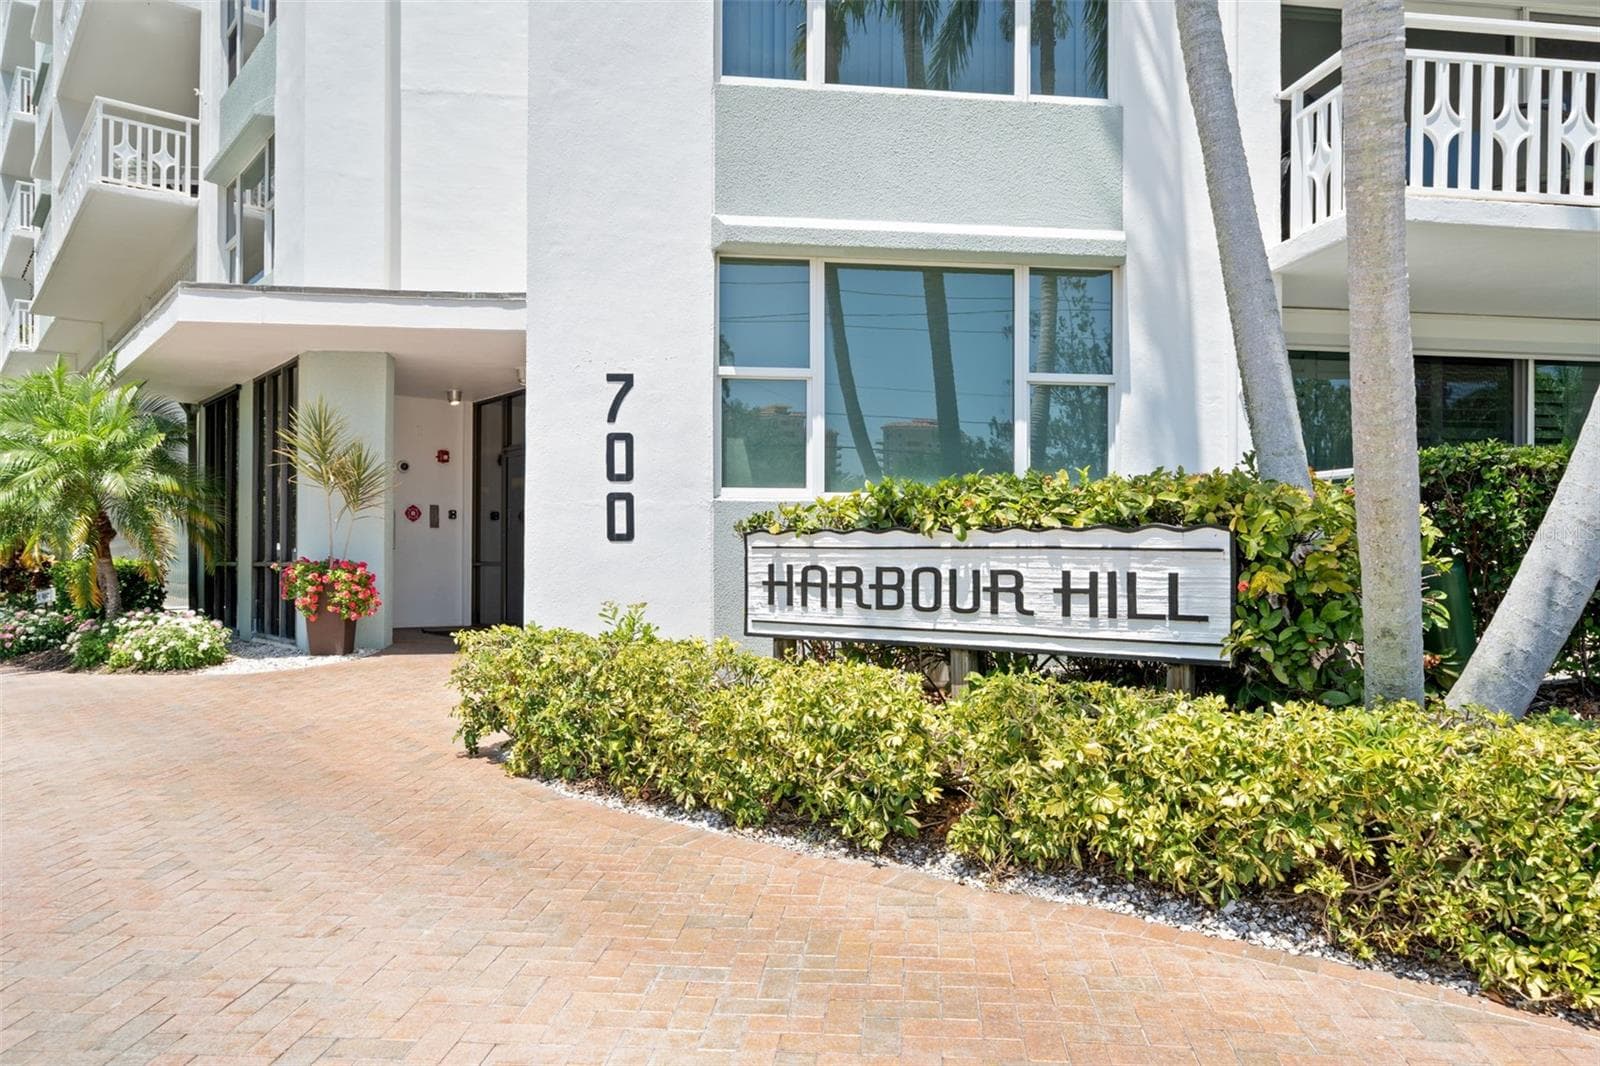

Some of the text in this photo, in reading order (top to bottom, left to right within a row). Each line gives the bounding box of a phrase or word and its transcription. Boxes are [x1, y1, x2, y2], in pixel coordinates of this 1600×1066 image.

[606, 373, 635, 542] 700
[761, 563, 1209, 623] HARBOUR HILL
